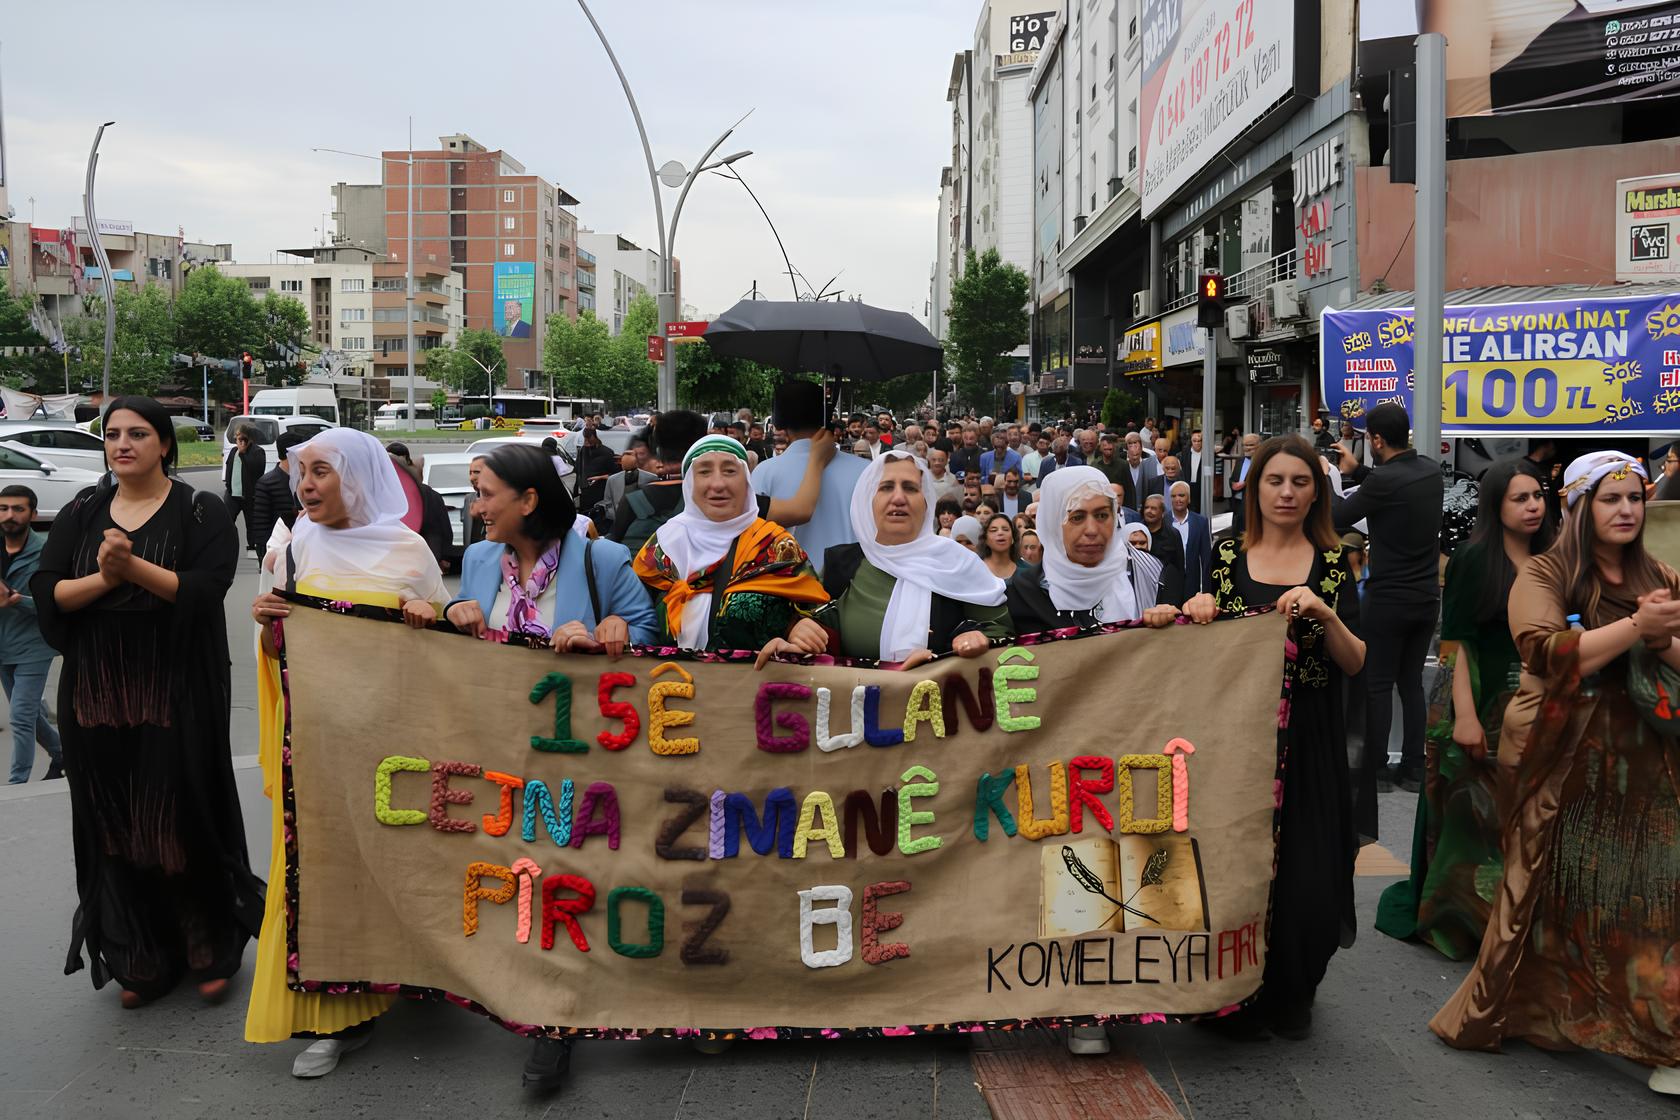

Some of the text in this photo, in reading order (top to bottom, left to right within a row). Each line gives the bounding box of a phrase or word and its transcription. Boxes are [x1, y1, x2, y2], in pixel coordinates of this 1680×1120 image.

[1012, 36, 1048, 51] GA
[1214, 21, 1231, 82] 72
[1443, 307, 1631, 334] NFLASYONA İNAT
[1479, 330, 1629, 361] ALIRSAN
[1445, 368, 1558, 418] 100
[1566, 387, 1597, 409] TL
[754, 646, 1042, 753] GULANÊ
[375, 755, 621, 850] CEJNA
[655, 765, 945, 861] ZIMANÊ
[797, 880, 912, 968] BE
